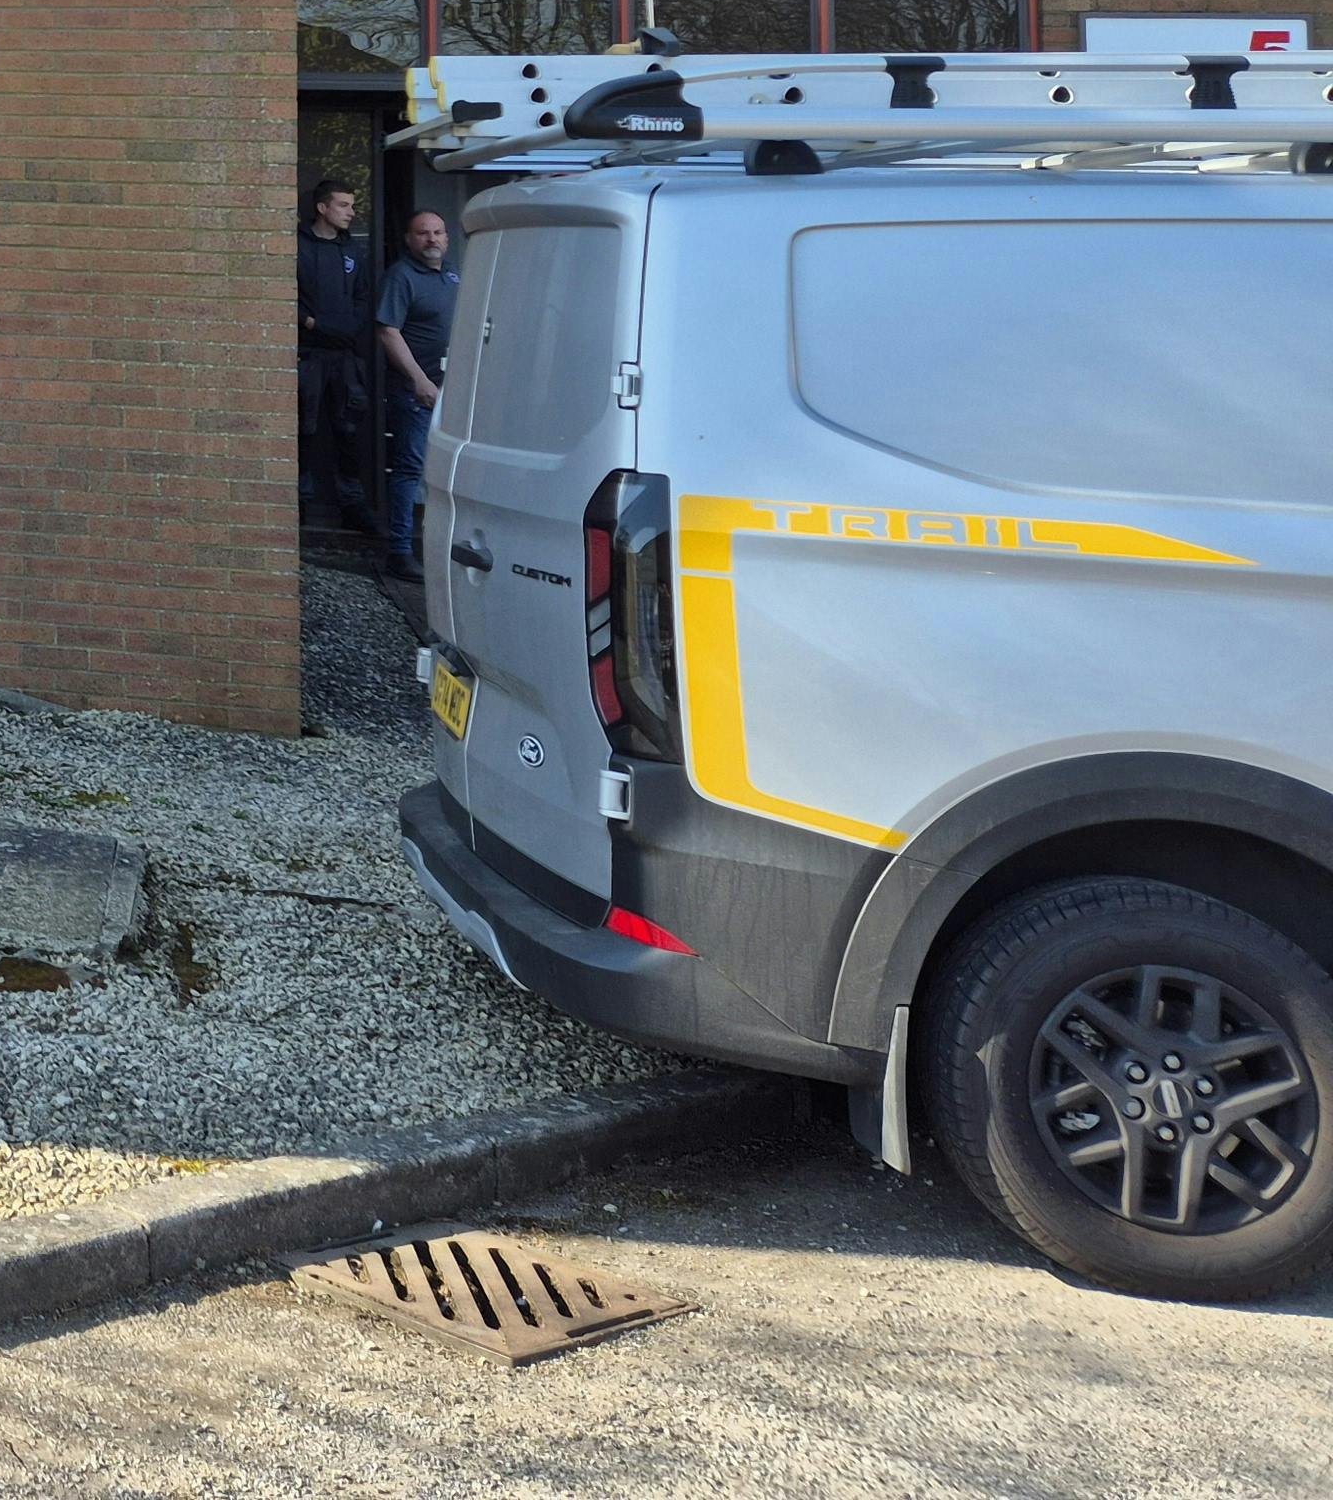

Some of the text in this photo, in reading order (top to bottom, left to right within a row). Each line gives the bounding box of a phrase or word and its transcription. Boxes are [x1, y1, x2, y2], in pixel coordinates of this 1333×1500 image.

[630, 117, 685, 132] Rhino
[752, 501, 1081, 553] TRAIL
[512, 563, 572, 588] CUSTOM
